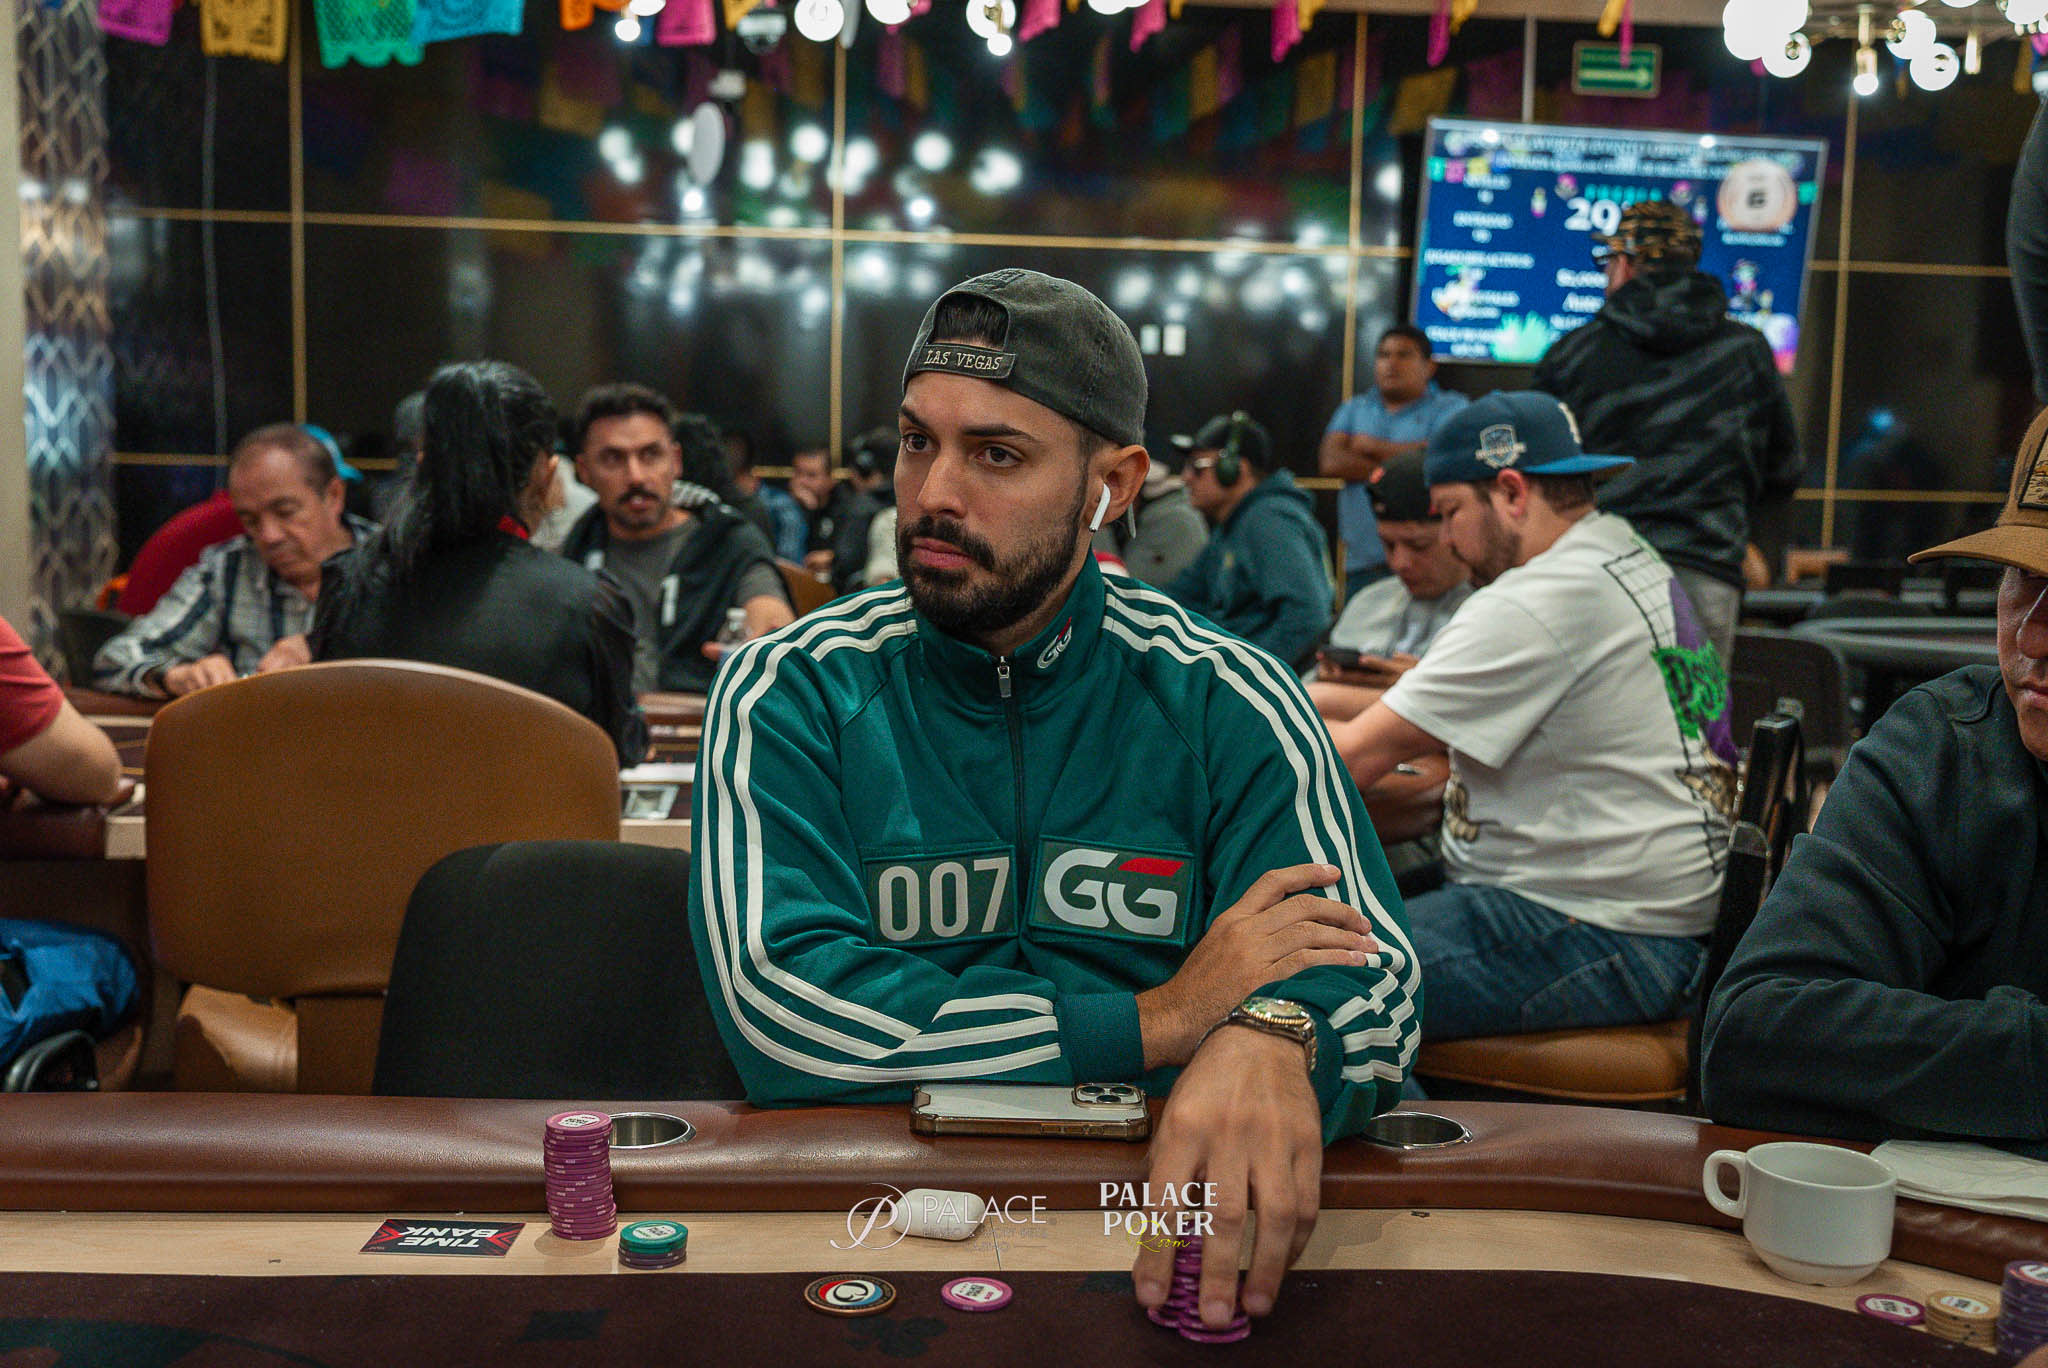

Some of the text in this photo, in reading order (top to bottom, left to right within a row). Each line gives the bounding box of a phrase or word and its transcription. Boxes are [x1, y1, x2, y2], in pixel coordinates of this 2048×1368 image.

[924, 350, 1004, 370] LAS VEGAS
[878, 856, 1011, 941] 007
[1043, 848, 1185, 937] GG
[398, 1226, 500, 1238] BANK
[398, 1236, 480, 1248] TIME
